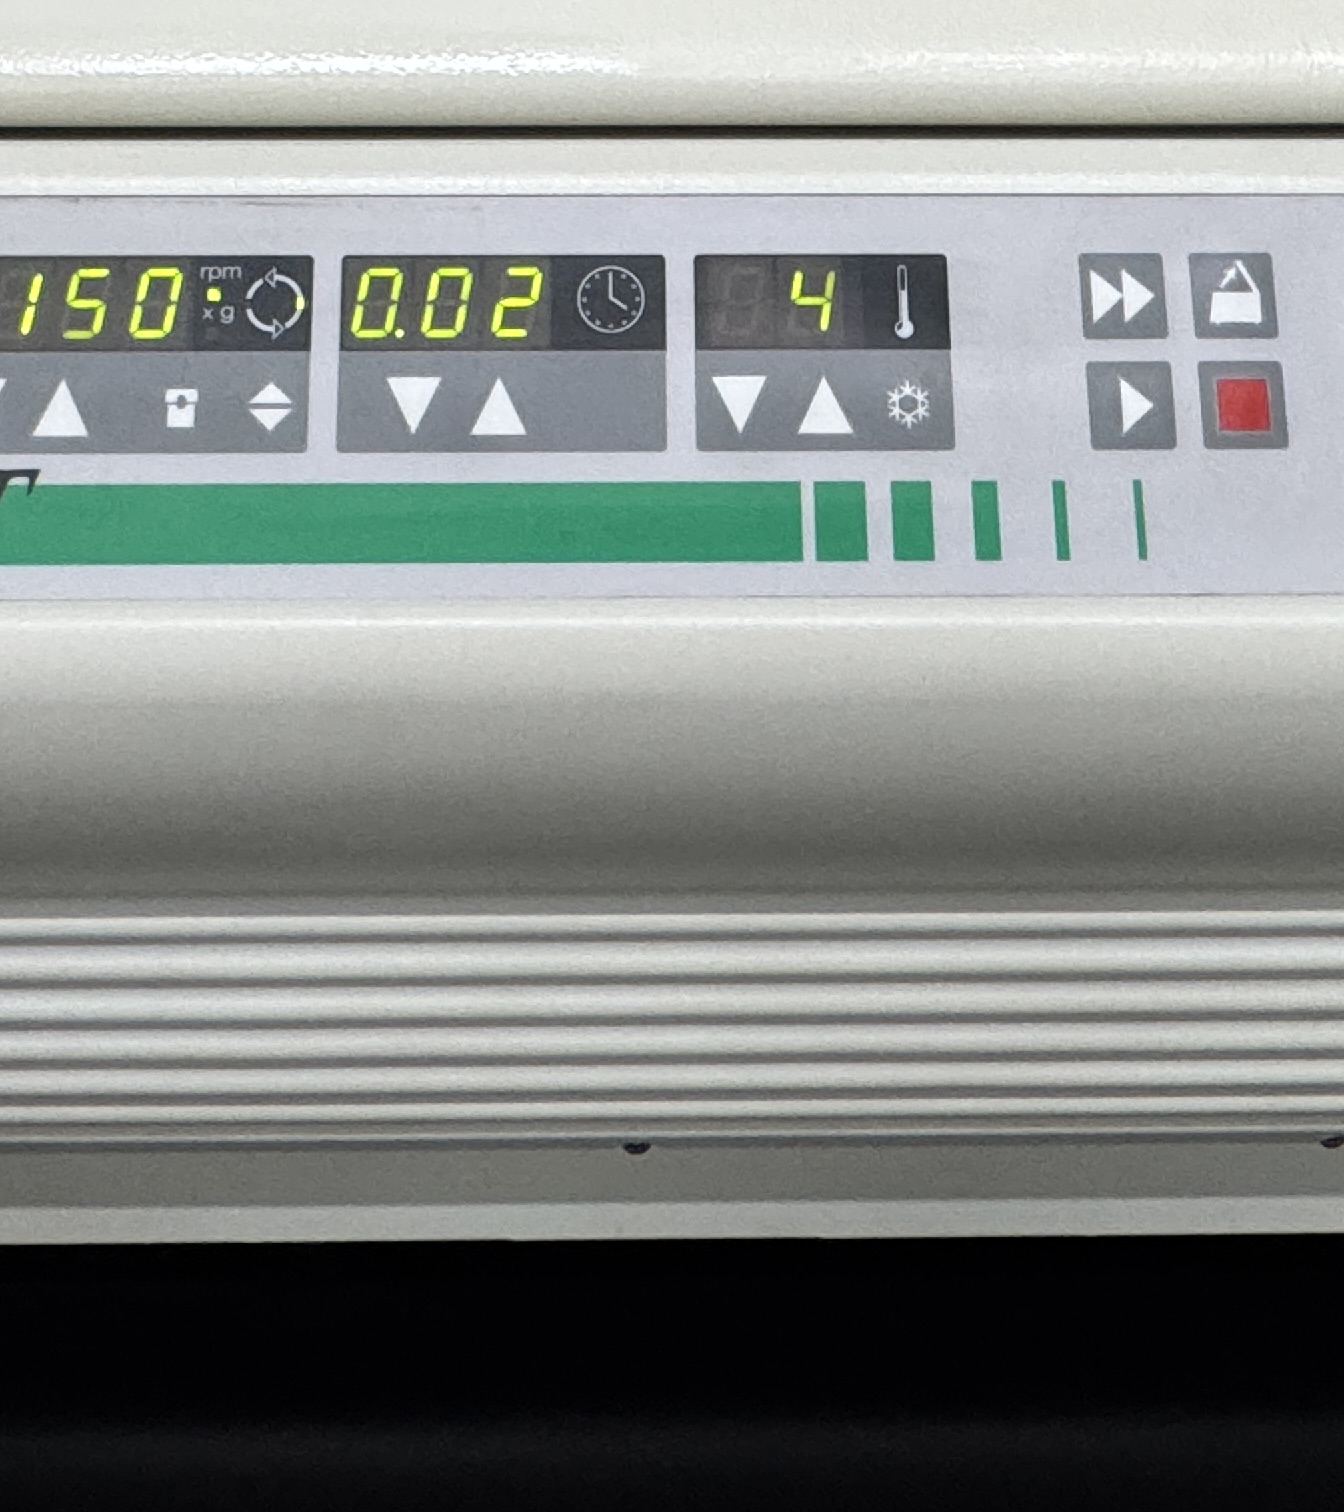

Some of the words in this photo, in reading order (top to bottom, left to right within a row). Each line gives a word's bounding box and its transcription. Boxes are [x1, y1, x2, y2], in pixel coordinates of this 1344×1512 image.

[199, 265, 242, 282] rpm
[350, 266, 545, 339] 0.02
[789, 269, 836, 332] 4
